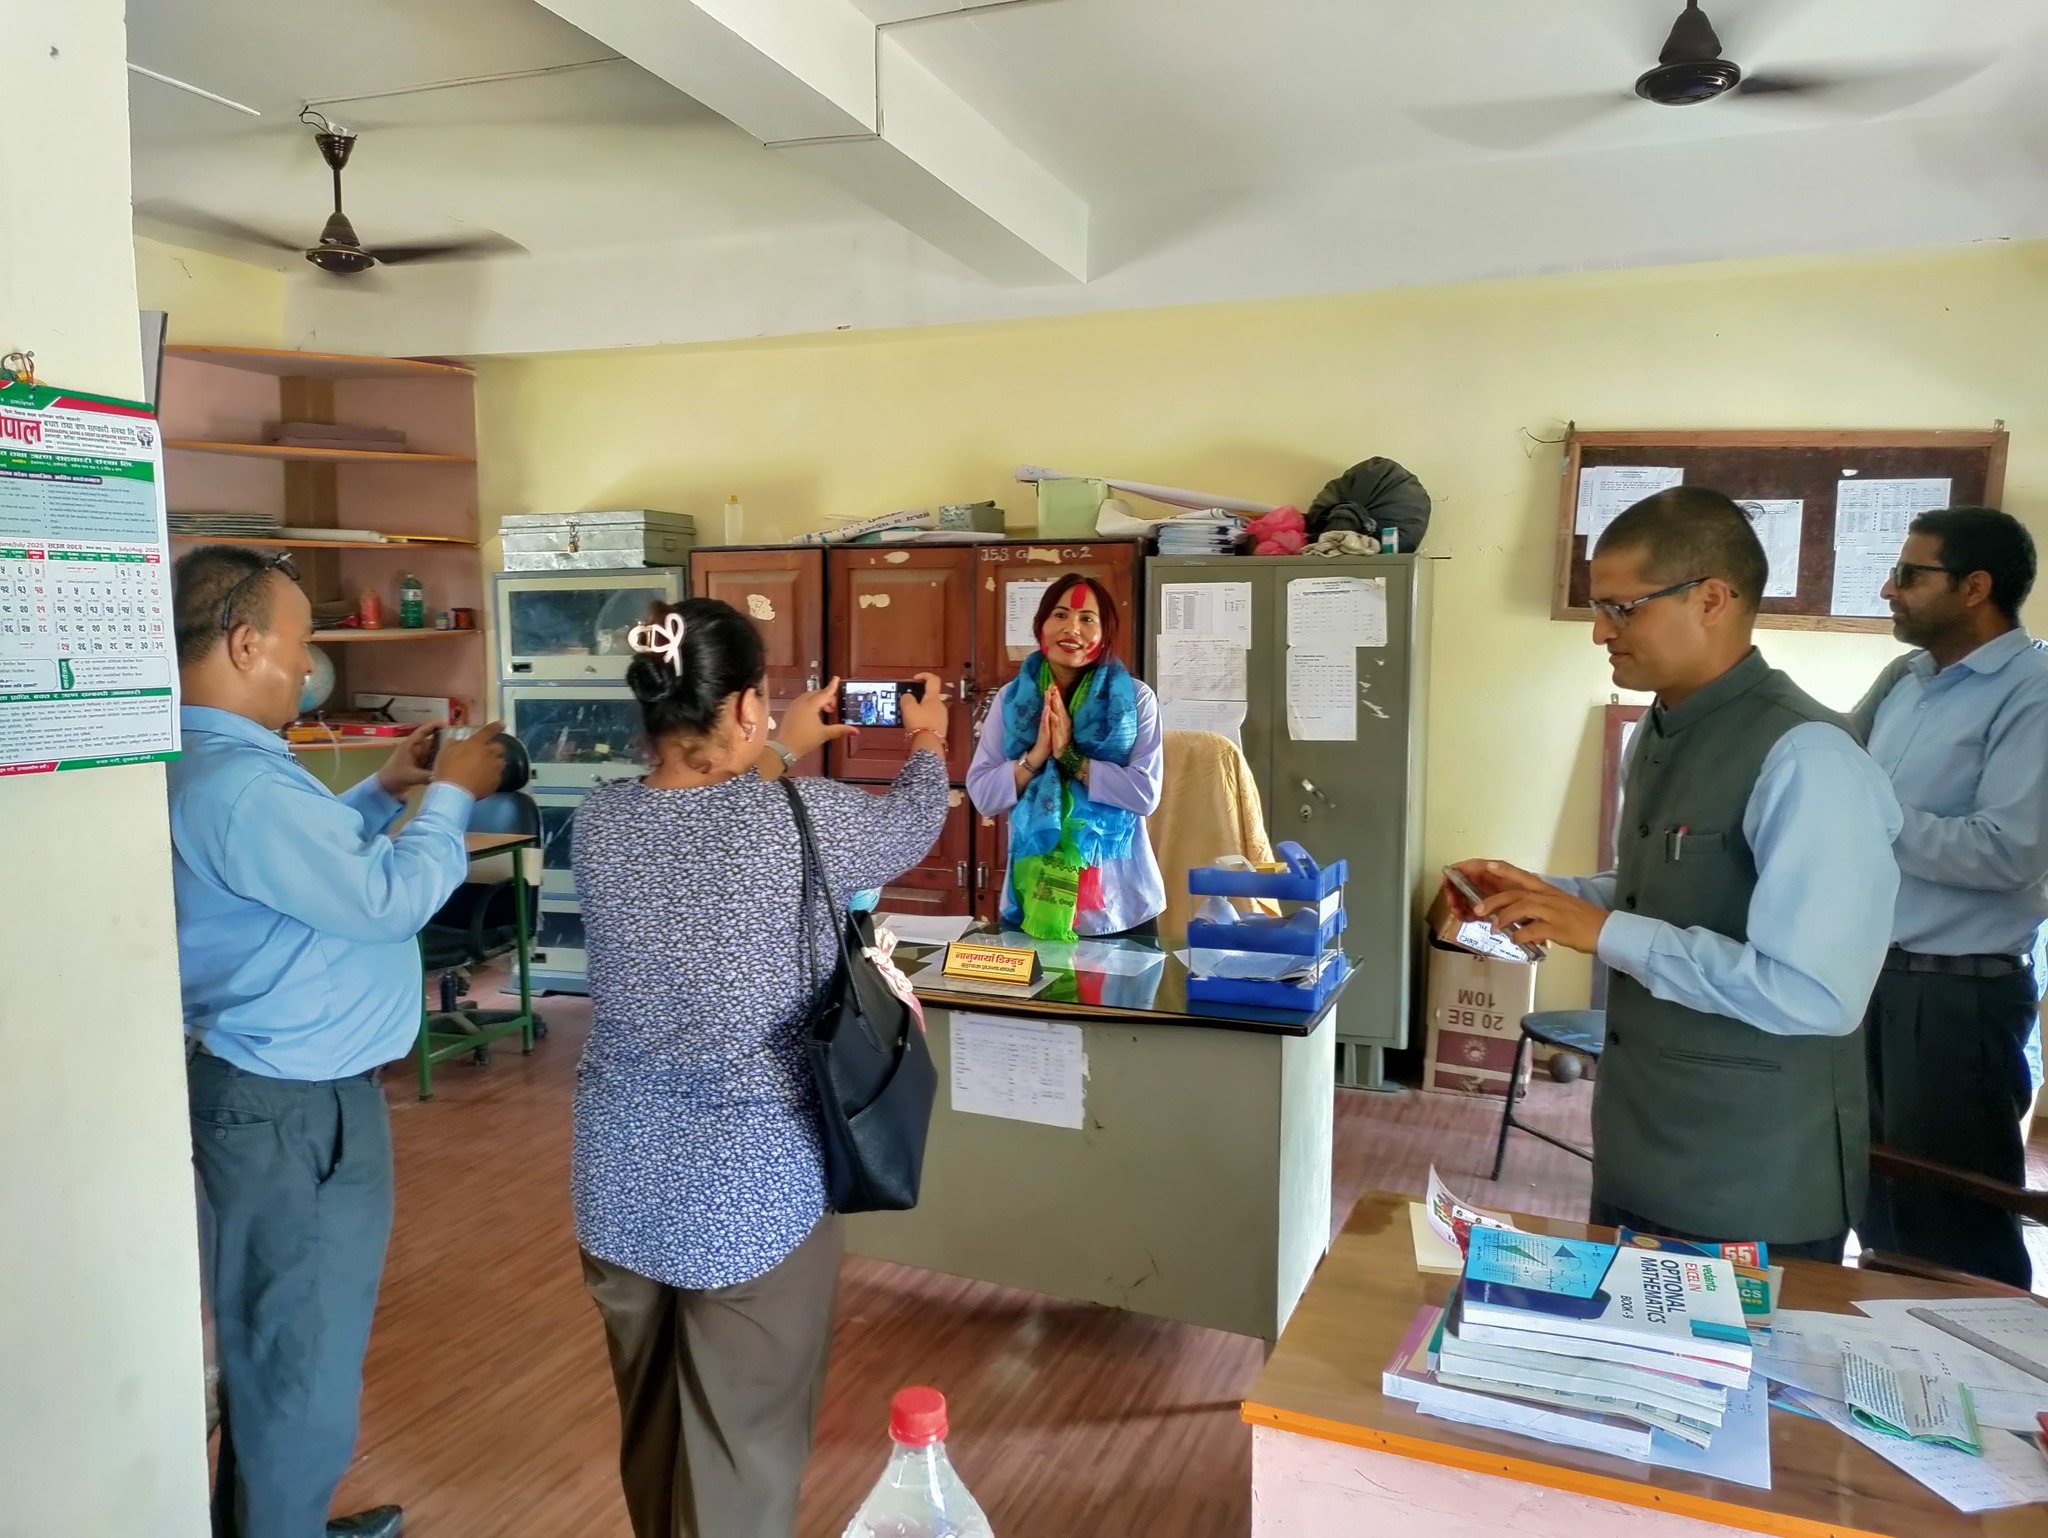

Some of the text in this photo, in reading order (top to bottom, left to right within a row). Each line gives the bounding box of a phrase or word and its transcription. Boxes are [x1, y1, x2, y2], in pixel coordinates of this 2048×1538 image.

[1458, 989, 1496, 1008] 10M
[1448, 1008, 1504, 1031] 20 BE
[1640, 1256, 1666, 1324] MATHEMATICS
[1661, 1259, 1687, 1313] OPTIONAL
[1685, 1262, 1702, 1293] EXCEL IN
[1702, 1264, 1718, 1292] vedanta
[1620, 1295, 1633, 1312] BOOK
